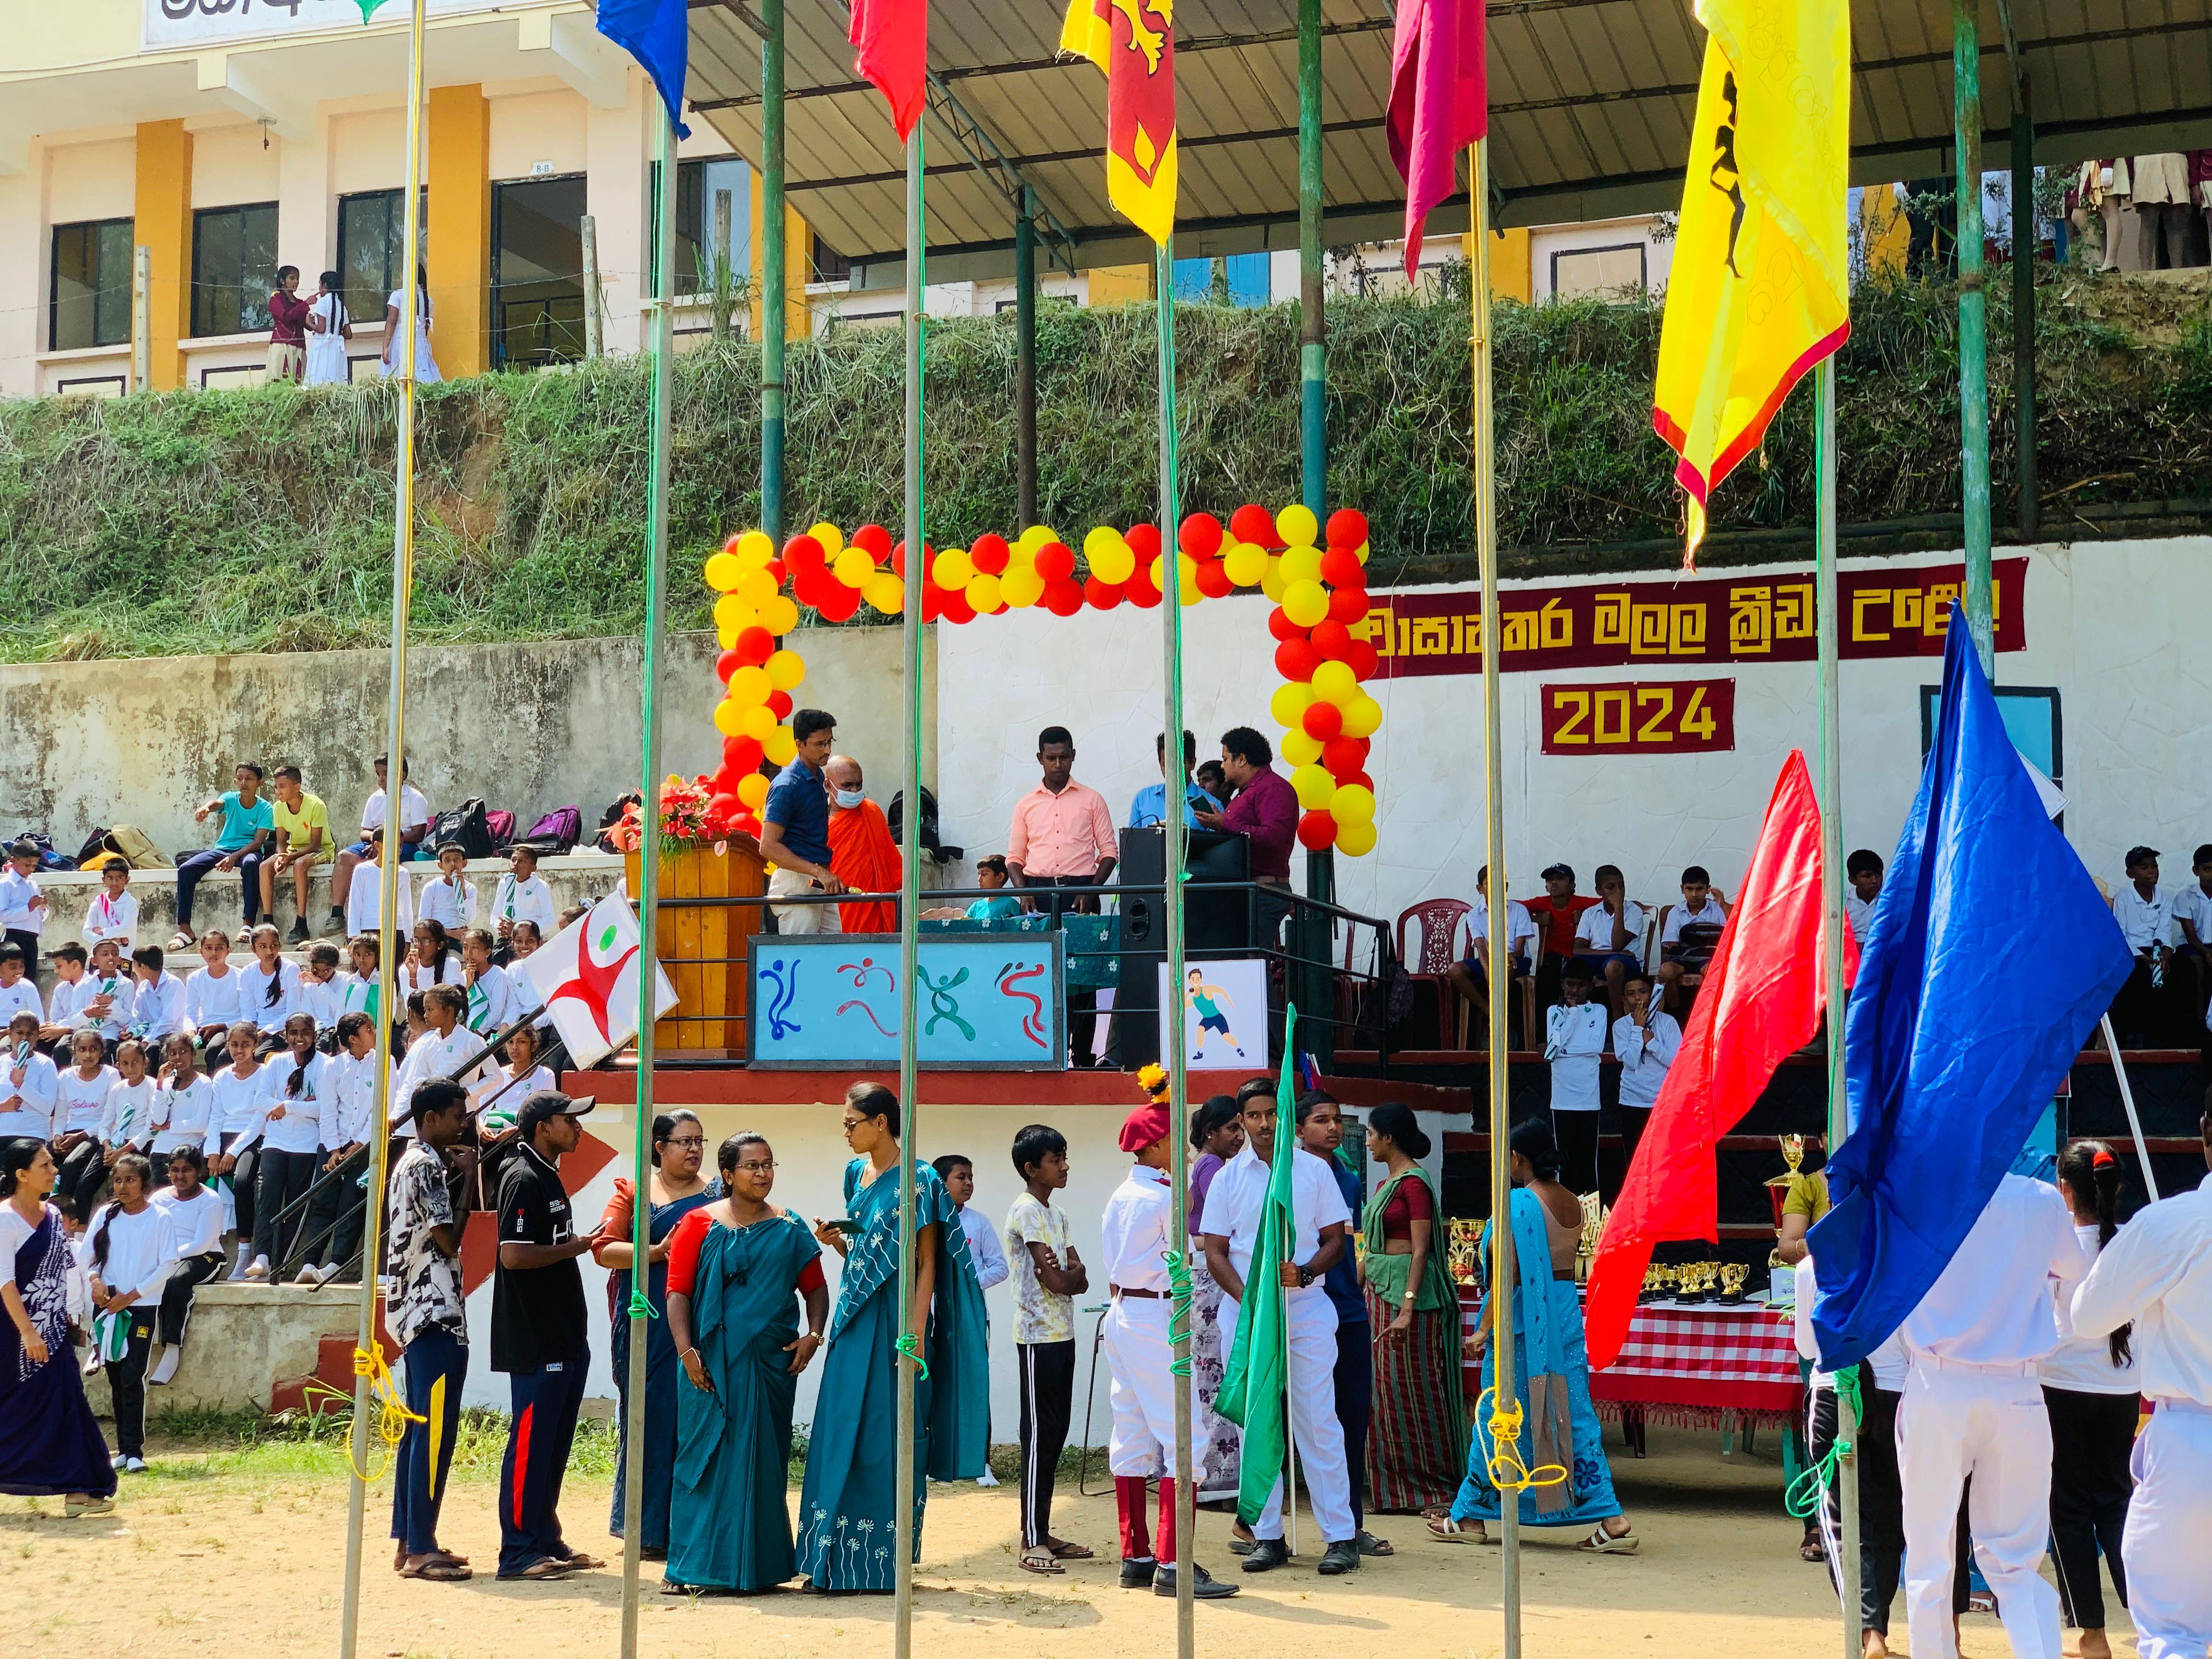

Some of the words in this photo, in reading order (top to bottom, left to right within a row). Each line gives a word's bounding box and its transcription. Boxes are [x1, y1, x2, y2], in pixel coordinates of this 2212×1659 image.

[536, 165, 550, 173] 8-B
[1593, 592, 1707, 655] මලල
[1553, 686, 1717, 744] 2024
